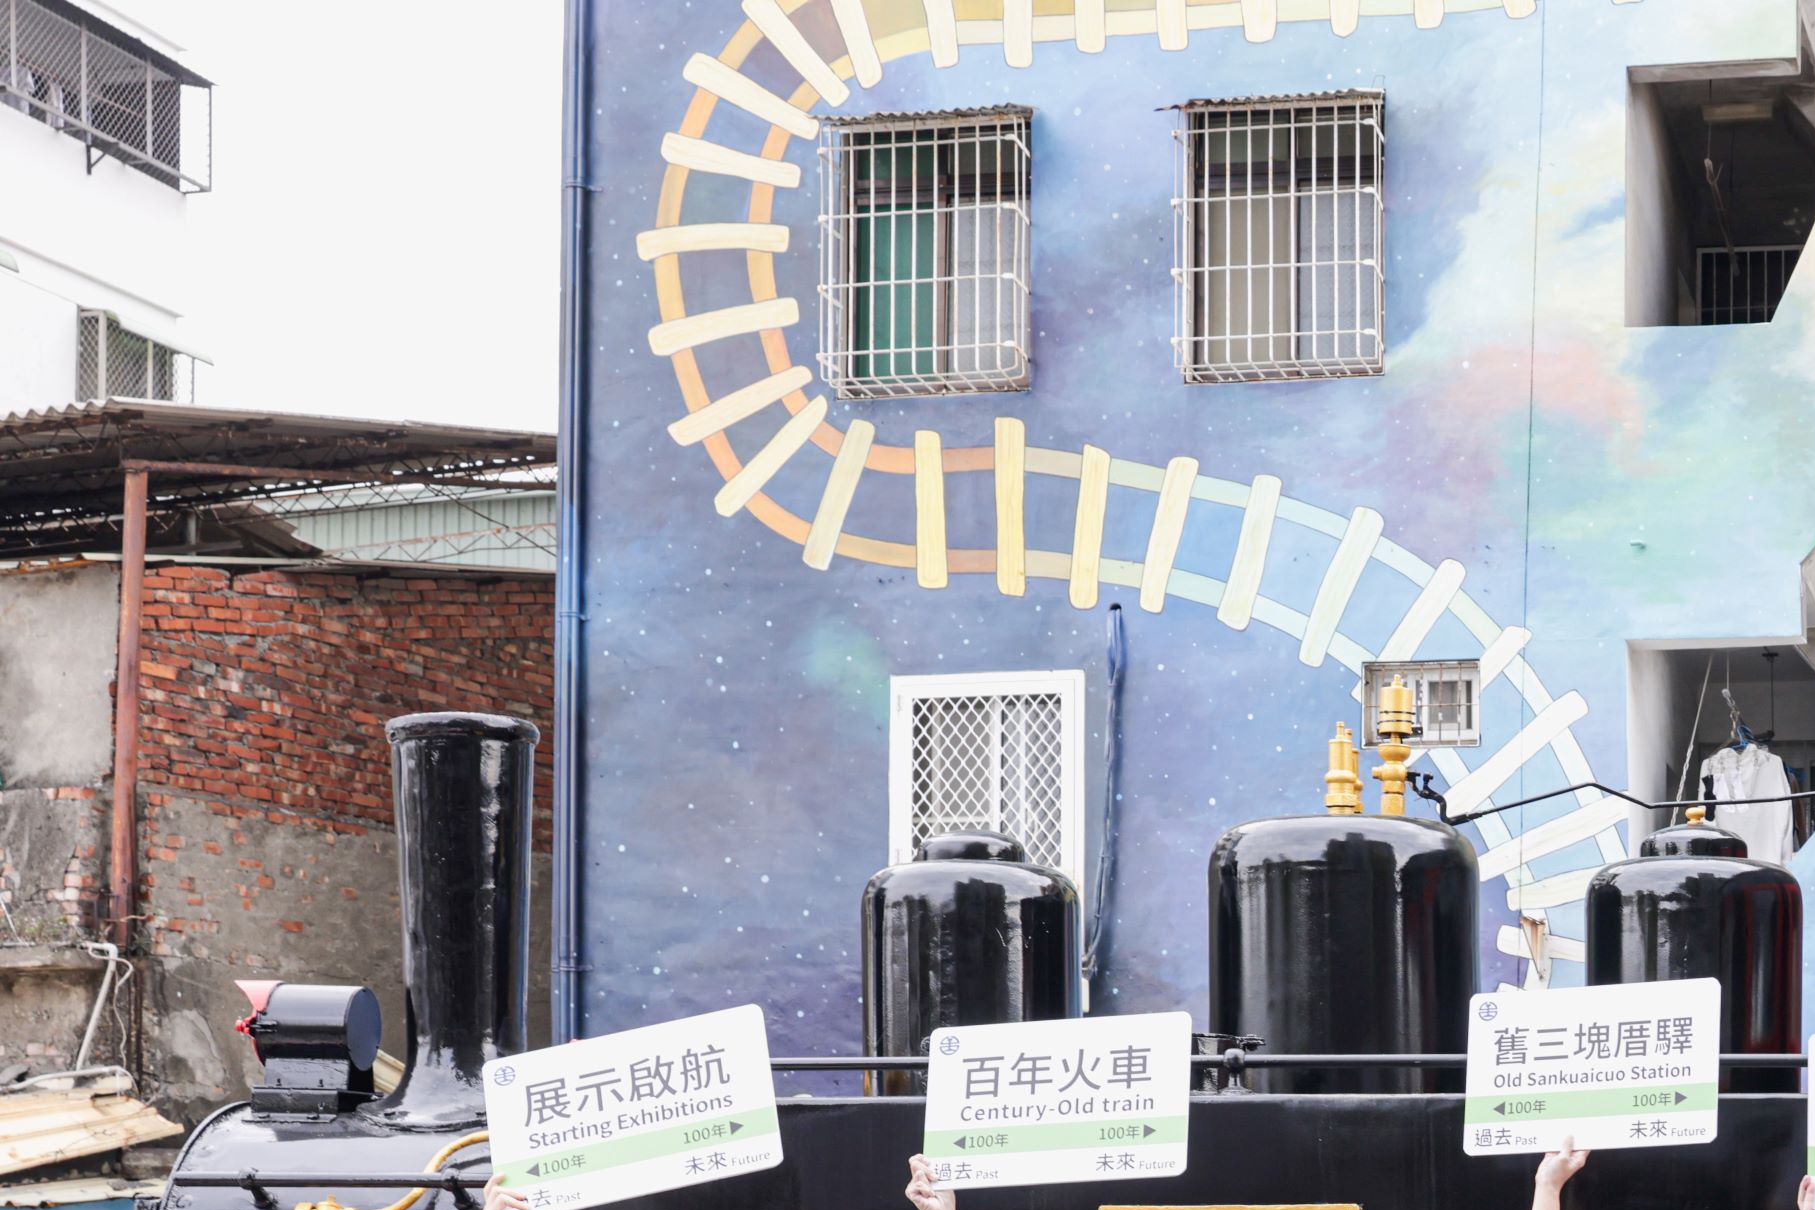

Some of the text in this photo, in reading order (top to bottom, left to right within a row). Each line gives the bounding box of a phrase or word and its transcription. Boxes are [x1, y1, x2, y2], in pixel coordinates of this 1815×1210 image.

[1495, 1017, 1693, 1065] 舊三塊厝驛
[963, 1045, 1151, 1099] 百年火車
[1494, 1064, 1690, 1088] Old Sankuaicuo Station
[525, 1044, 730, 1127] 展示啟航
[961, 1094, 1153, 1121] Century-Old train
[1508, 1100, 1546, 1114] 100年
[1633, 1093, 1671, 1107] 100年
[529, 1095, 732, 1149] Starting Exhibitions
[1630, 1120, 1707, 1138] 未來 Future
[684, 1124, 726, 1144] 100年
[969, 1134, 1008, 1148] 100年
[1100, 1126, 1139, 1140] 100年
[1475, 1128, 1537, 1146] 過去 Past
[544, 1155, 586, 1175] 100年
[686, 1152, 771, 1174] 未來 Future
[934, 1161, 999, 1182] 過去 Past
[1096, 1152, 1176, 1171] 未來 Future
[521, 1188, 582, 1210] 去 Past
